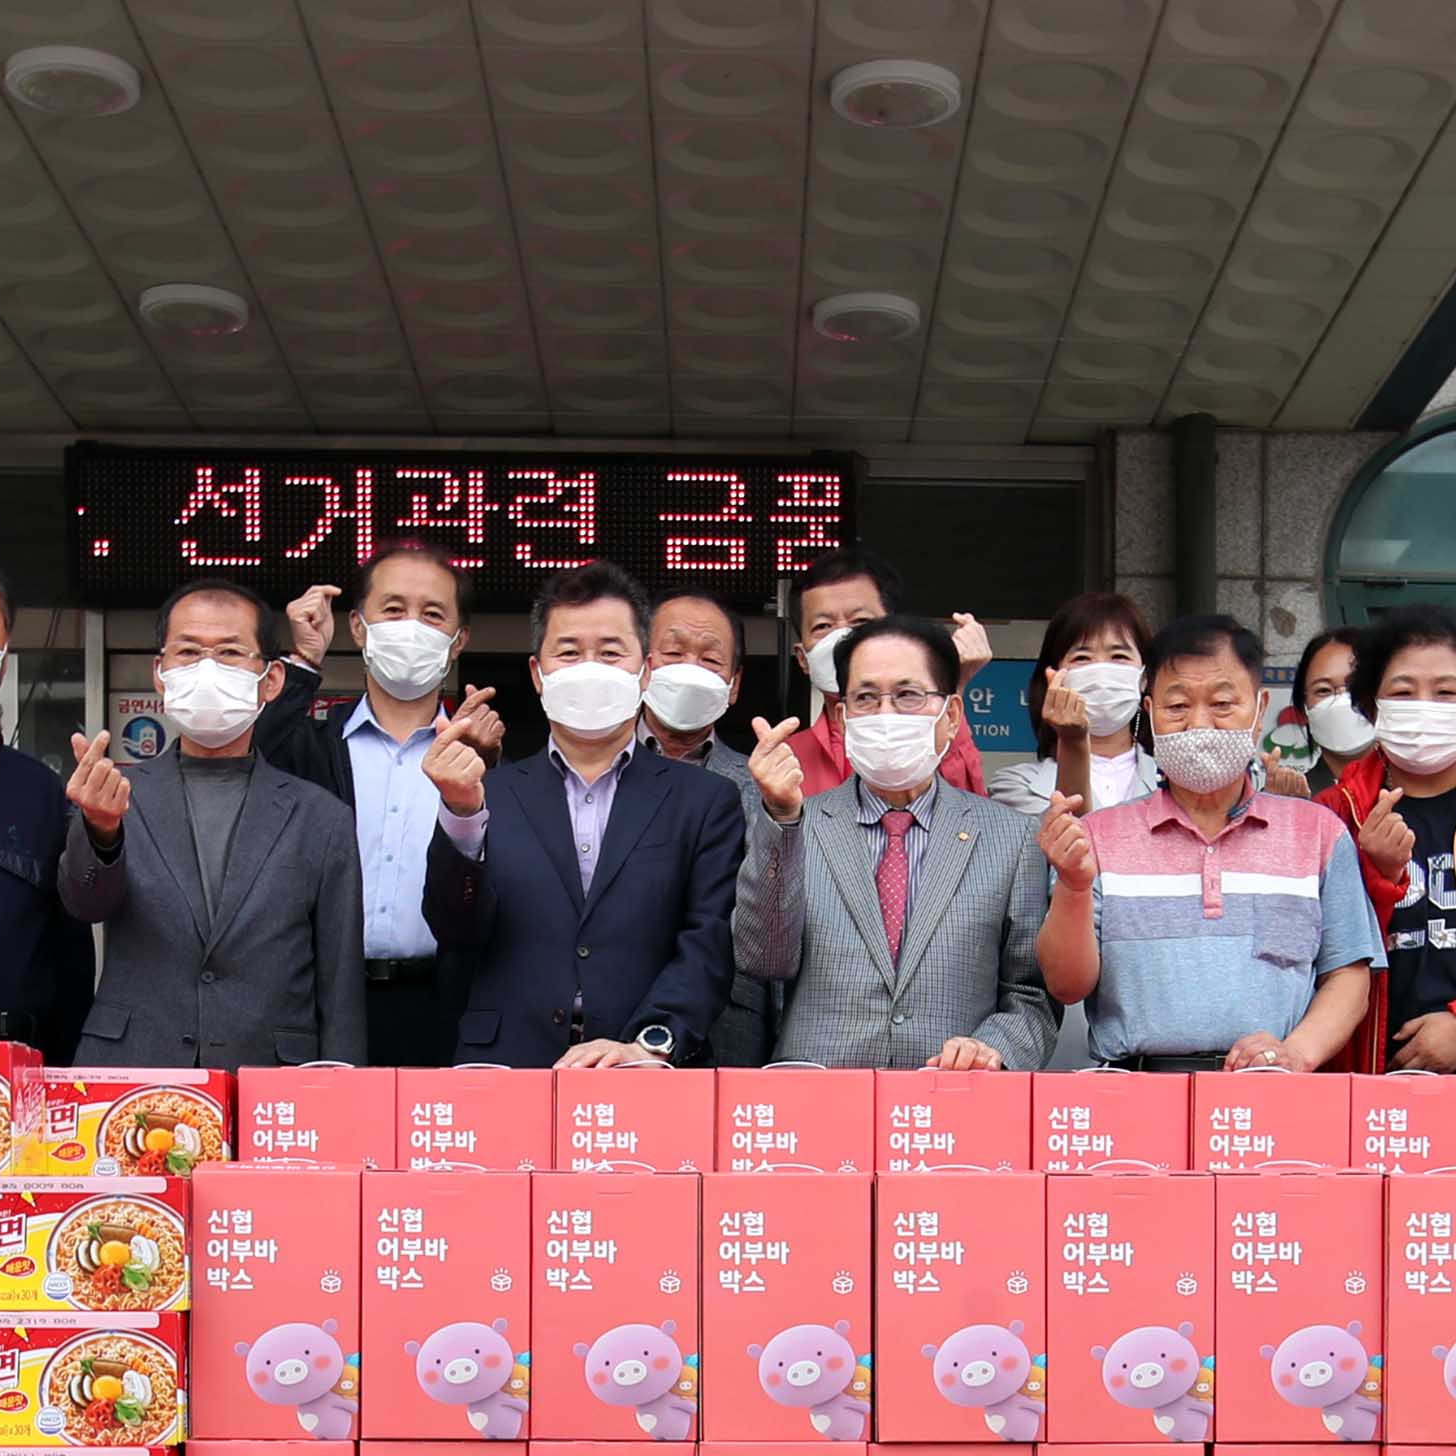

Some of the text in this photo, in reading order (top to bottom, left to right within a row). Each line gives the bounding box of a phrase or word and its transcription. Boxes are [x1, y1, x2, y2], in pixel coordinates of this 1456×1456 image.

[174, 467, 841, 571] 선거관련 금품
[253, 1102, 295, 1125] 신협
[411, 1102, 453, 1126] 신협
[572, 1103, 614, 1127] 신협
[732, 1103, 774, 1127] 신협
[890, 1104, 932, 1128] 신협
[1048, 1106, 1090, 1130] 신협
[1210, 1107, 1252, 1130] 신협
[1366, 1108, 1407, 1132] 신협
[253, 1129, 319, 1152] 어부바
[411, 1130, 477, 1153] 어부바
[572, 1131, 638, 1154] 어부바
[732, 1132, 798, 1154] 어부바
[890, 1132, 955, 1155] 어부바
[1048, 1134, 1114, 1157] 어부바
[1209, 1134, 1275, 1157] 어부바
[1365, 1135, 1431, 1159] 어부바
[207, 1209, 252, 1234] 신협
[377, 1207, 422, 1233] 신협
[547, 1209, 592, 1235] 신협
[719, 1211, 764, 1236] 신협
[893, 1211, 938, 1236] 신협
[1063, 1212, 1108, 1238] 신협
[1231, 1211, 1276, 1237] 신협
[1406, 1212, 1451, 1237] 신협
[207, 1239, 278, 1263] 어부바
[377, 1237, 449, 1262] 어부바
[546, 1239, 618, 1264] 어부바
[719, 1241, 790, 1265] 어부바
[893, 1241, 965, 1265] 어부바
[1063, 1242, 1134, 1266] 어부바
[1231, 1241, 1302, 1265] 어부바
[207, 1268, 253, 1292] 박스
[377, 1266, 423, 1290] 박스
[546, 1268, 593, 1292] 박스
[719, 1270, 766, 1294] 박스
[893, 1270, 940, 1294] 박스
[1063, 1271, 1110, 1295] 박스
[1231, 1270, 1278, 1295] 박스
[1405, 1271, 1452, 1295] 박스
